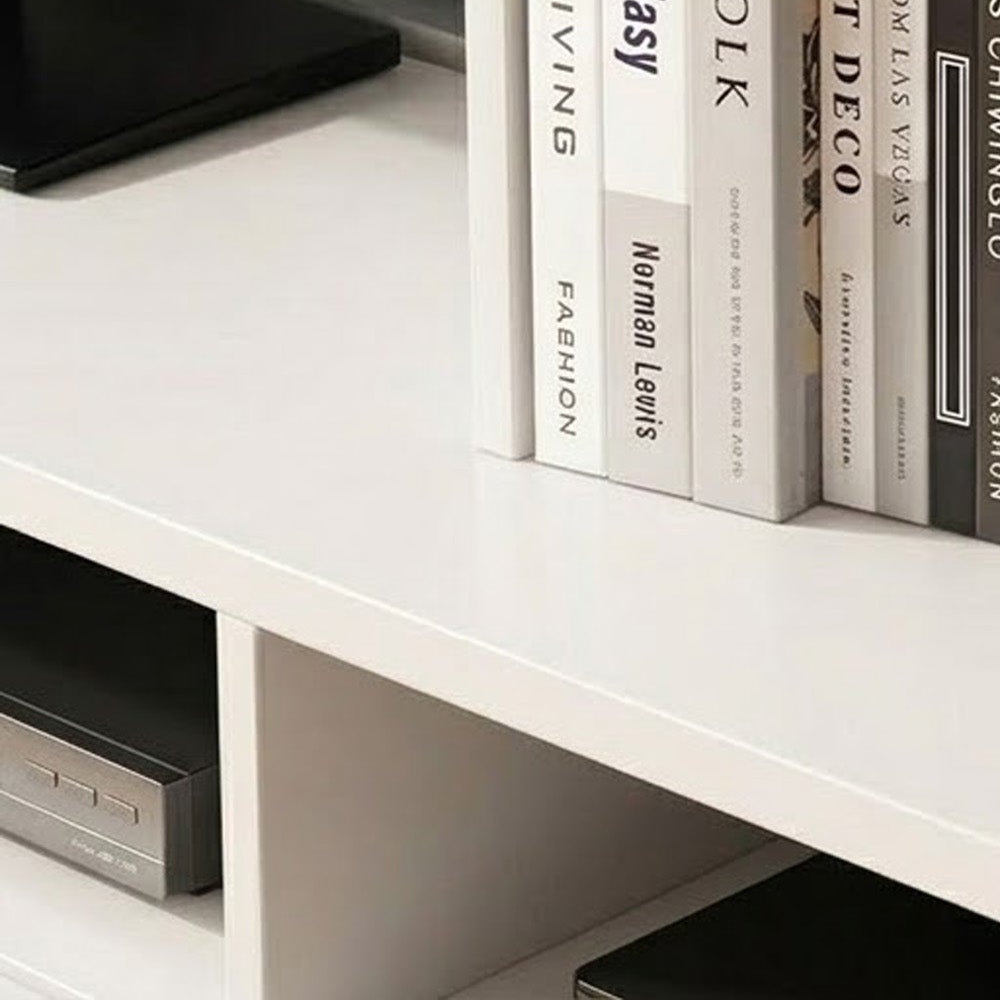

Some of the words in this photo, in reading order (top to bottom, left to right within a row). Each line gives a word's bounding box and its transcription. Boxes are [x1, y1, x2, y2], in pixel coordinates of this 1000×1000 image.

[832, 51, 862, 196] DECO
[891, 47, 911, 108] LAS
[632, 241, 661, 349] Norman
[634, 361, 663, 441] Lewis
